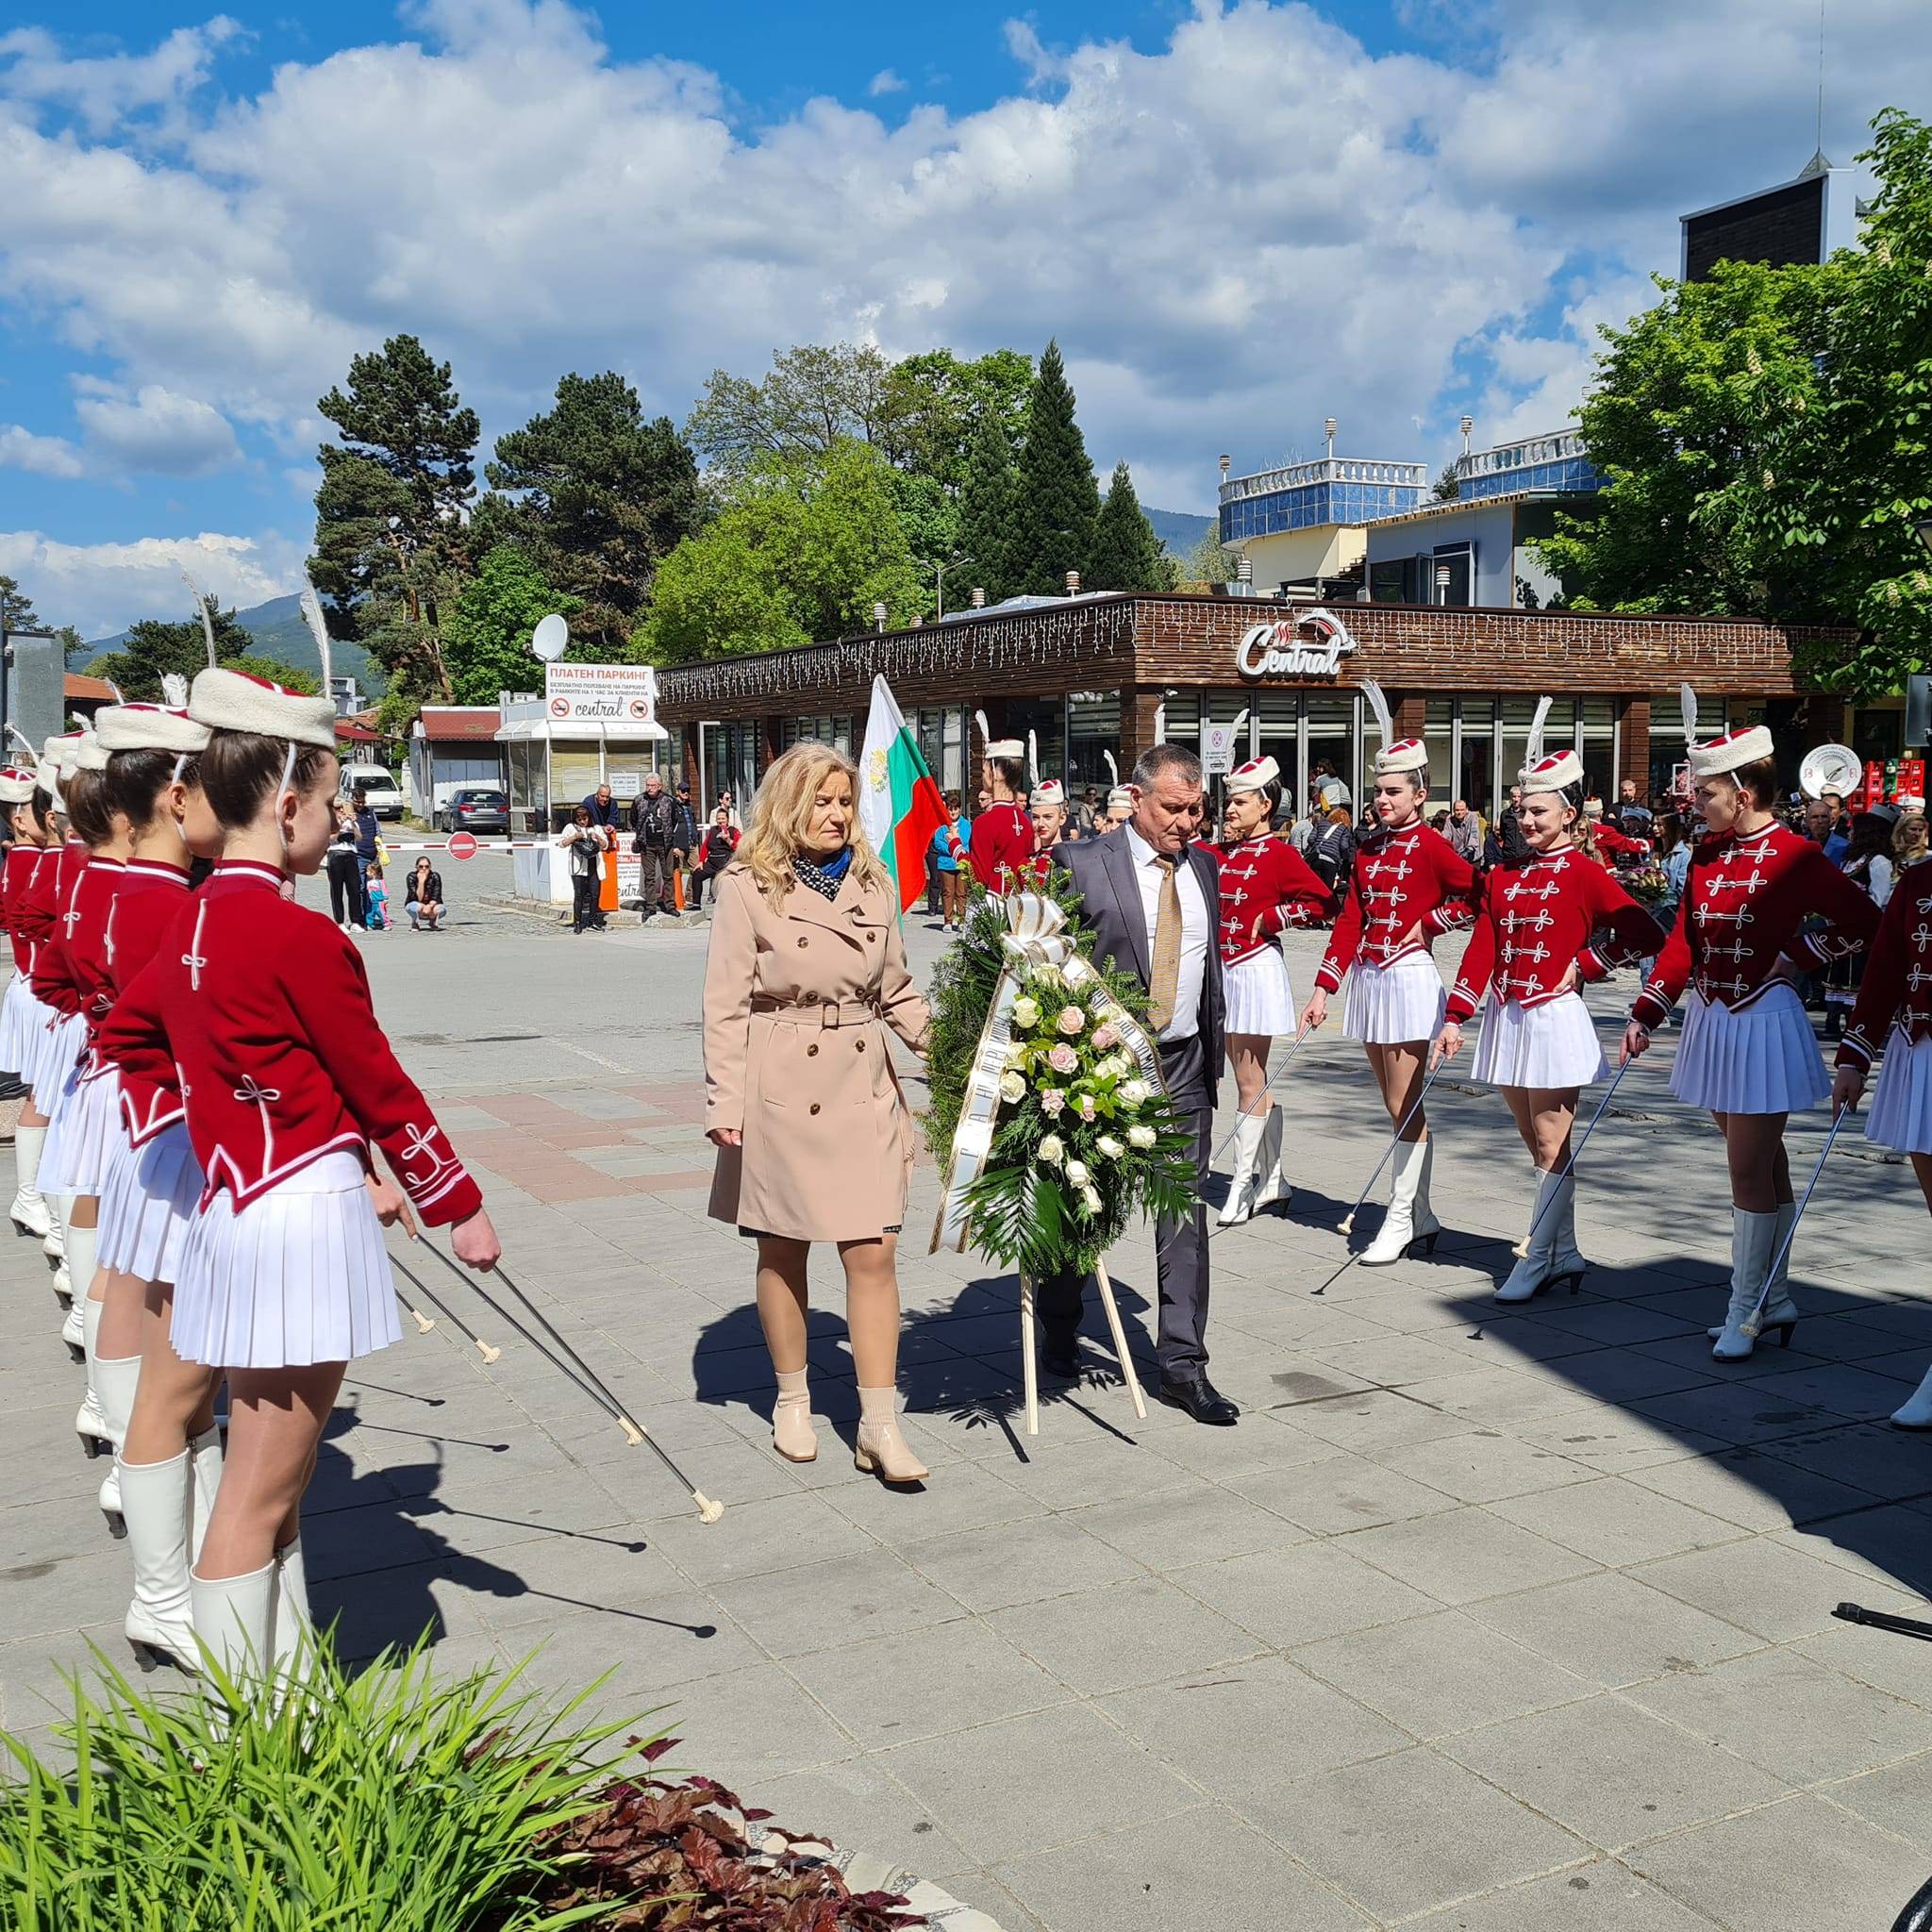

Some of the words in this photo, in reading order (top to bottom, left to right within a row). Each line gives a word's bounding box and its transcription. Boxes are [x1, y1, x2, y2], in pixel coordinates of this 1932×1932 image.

[1237, 624, 1347, 675] Central
[550, 668, 594, 679] ПЛАТЕН
[597, 669, 648, 680] ПАРКИНГ
[575, 696, 624, 717] central
